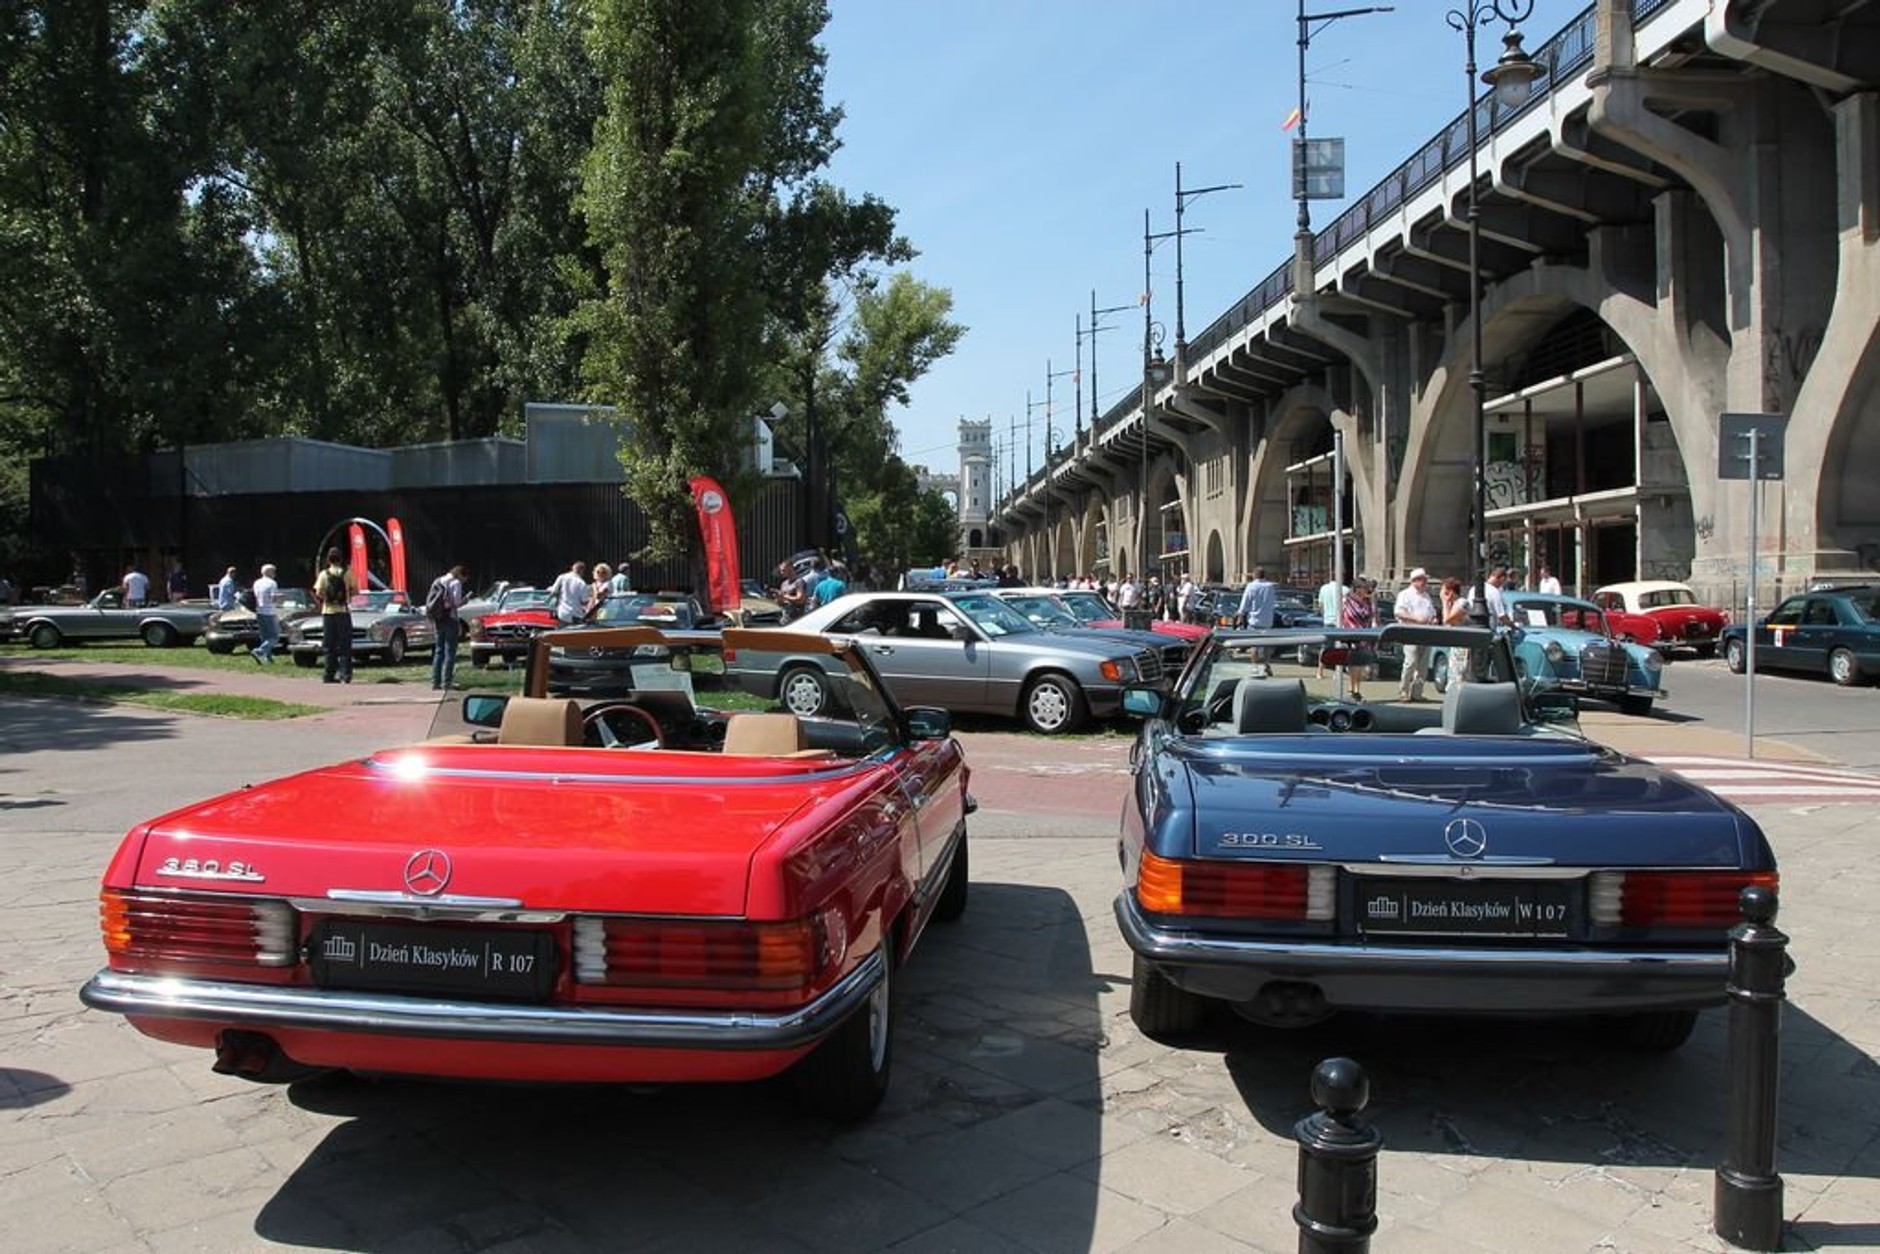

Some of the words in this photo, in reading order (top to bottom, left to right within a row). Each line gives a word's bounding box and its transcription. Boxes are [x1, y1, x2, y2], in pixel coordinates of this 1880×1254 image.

[1222, 833, 1278, 845] 300
[1285, 834, 1318, 846] SL
[227, 861, 260, 877] SL
[1411, 901, 1448, 917] Dzień
[1451, 901, 1511, 921] Klasyków
[369, 942, 409, 963] Dzień
[412, 944, 480, 970] Klasyków
[492, 954, 503, 971] R
[509, 954, 535, 973] 107
